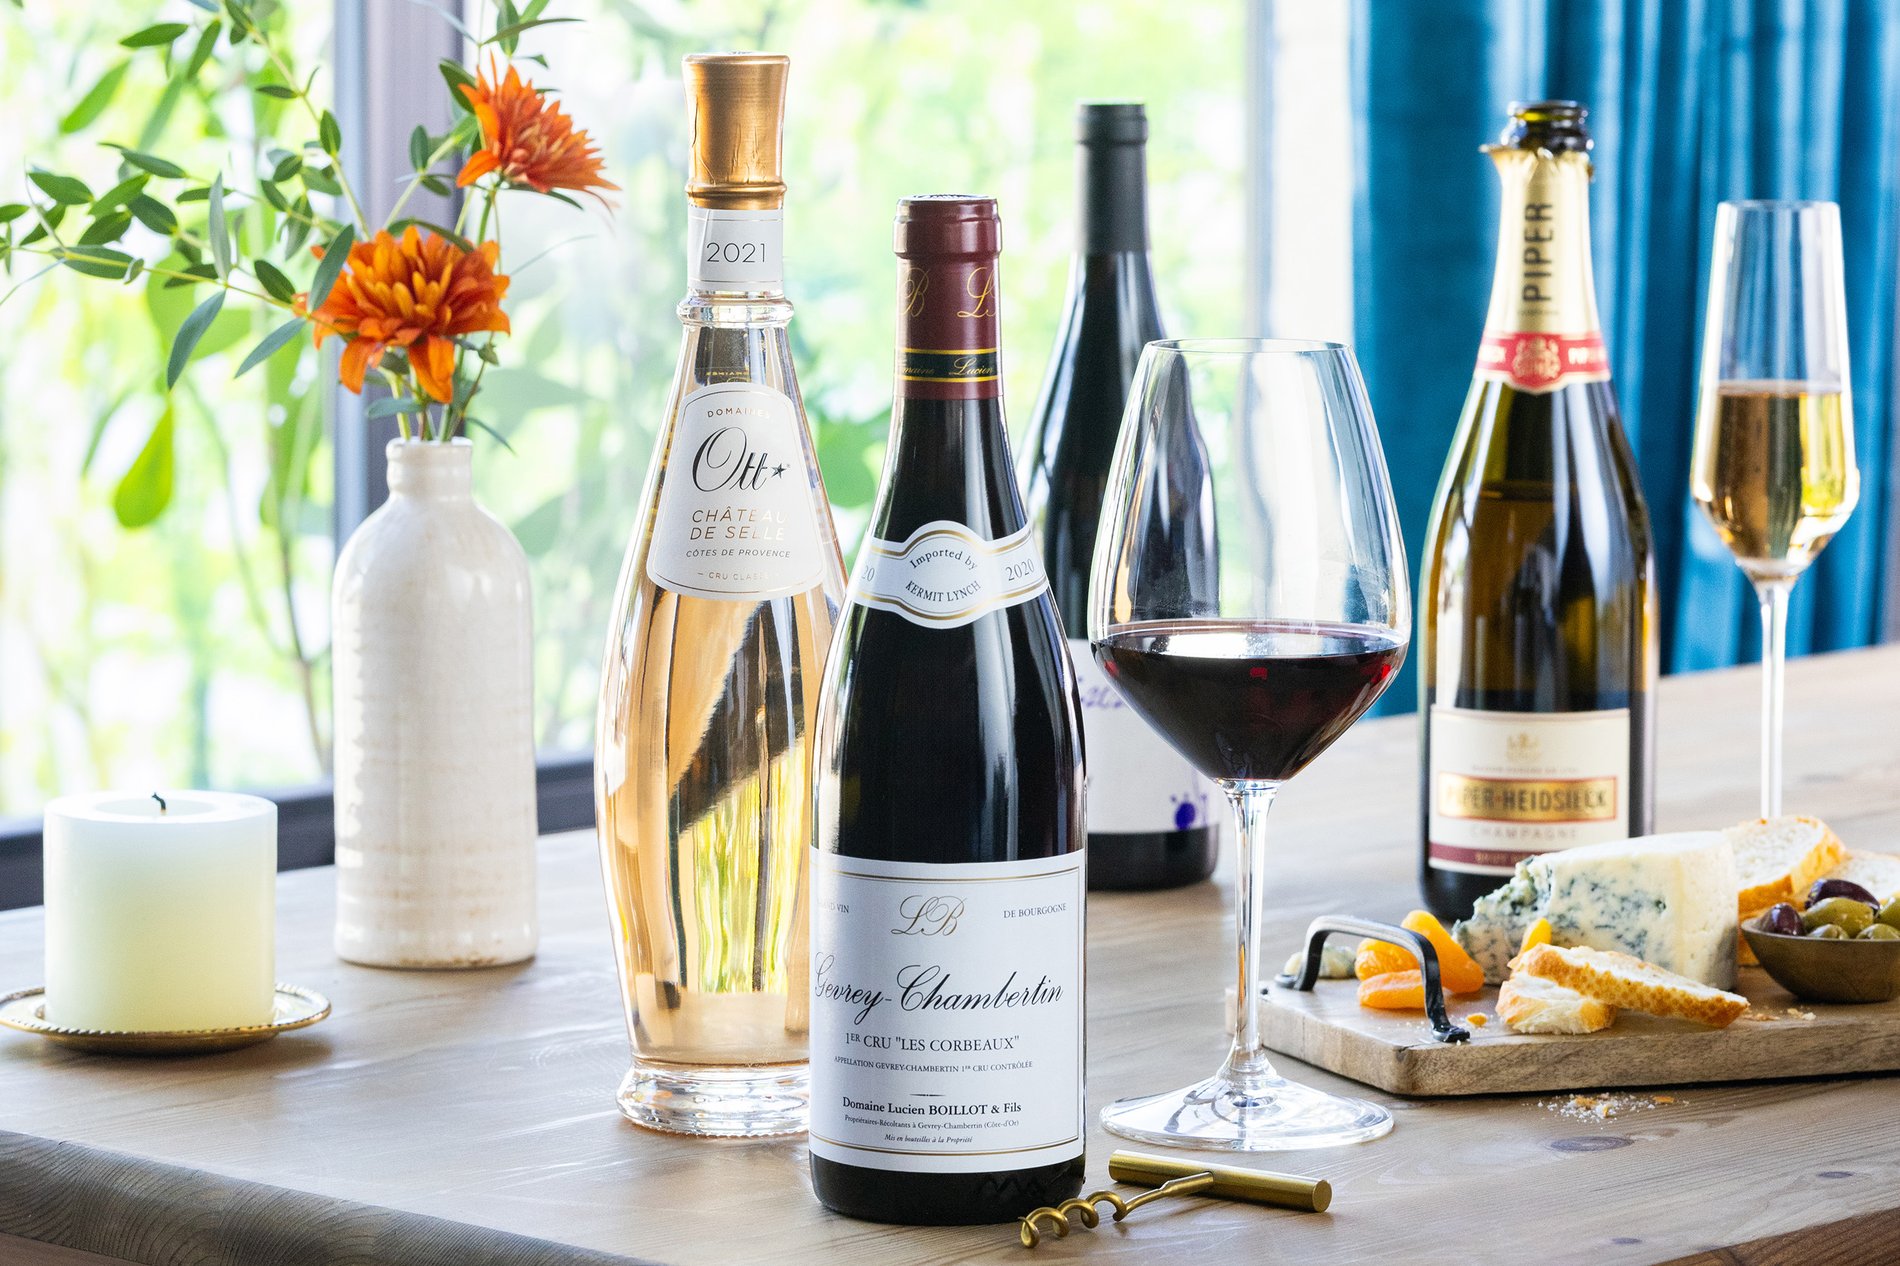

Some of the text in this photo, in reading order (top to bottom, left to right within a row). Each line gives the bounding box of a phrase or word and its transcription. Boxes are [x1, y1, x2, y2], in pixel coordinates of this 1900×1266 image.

[706, 242, 767, 263] 2021
[1522, 202, 1553, 302] PIPER
[948, 355, 994, 377] Lucien
[692, 426, 768, 492] Ott
[692, 506, 787, 524] CHÂTEAU
[690, 526, 785, 541] DE SELLE
[686, 548, 791, 559] CÔTES DE PROVENCE
[909, 549, 979, 571] Imported by
[708, 571, 729, 581] CRU
[1005, 557, 1035, 582] 2020
[905, 580, 982, 602] KERMIT LYNCH
[890, 894, 968, 936] LB
[1003, 903, 1067, 919] DE BOURGOGNE
[815, 951, 1064, 1026] Gevrey-Chambertin
[863, 1035, 892, 1050] CRU
[895, 1036, 926, 1052] "LES
[929, 1034, 1020, 1052] CORBEAUX"
[834, 1055, 874, 1069] APPELLATION
[875, 1062, 959, 1073] GEVREY-CHAMBERTIN
[972, 1064, 989, 1073] CRU
[990, 1059, 1033, 1071] CONTRÔLÉE
[843, 1096, 1022, 1116] Domaine Lucien BOILLOT & Fils
[917, 1121, 983, 1131] Gevrey-Chambertin
[884, 1133, 896, 1142] Mis
[905, 1134, 931, 1143] bouteilles
